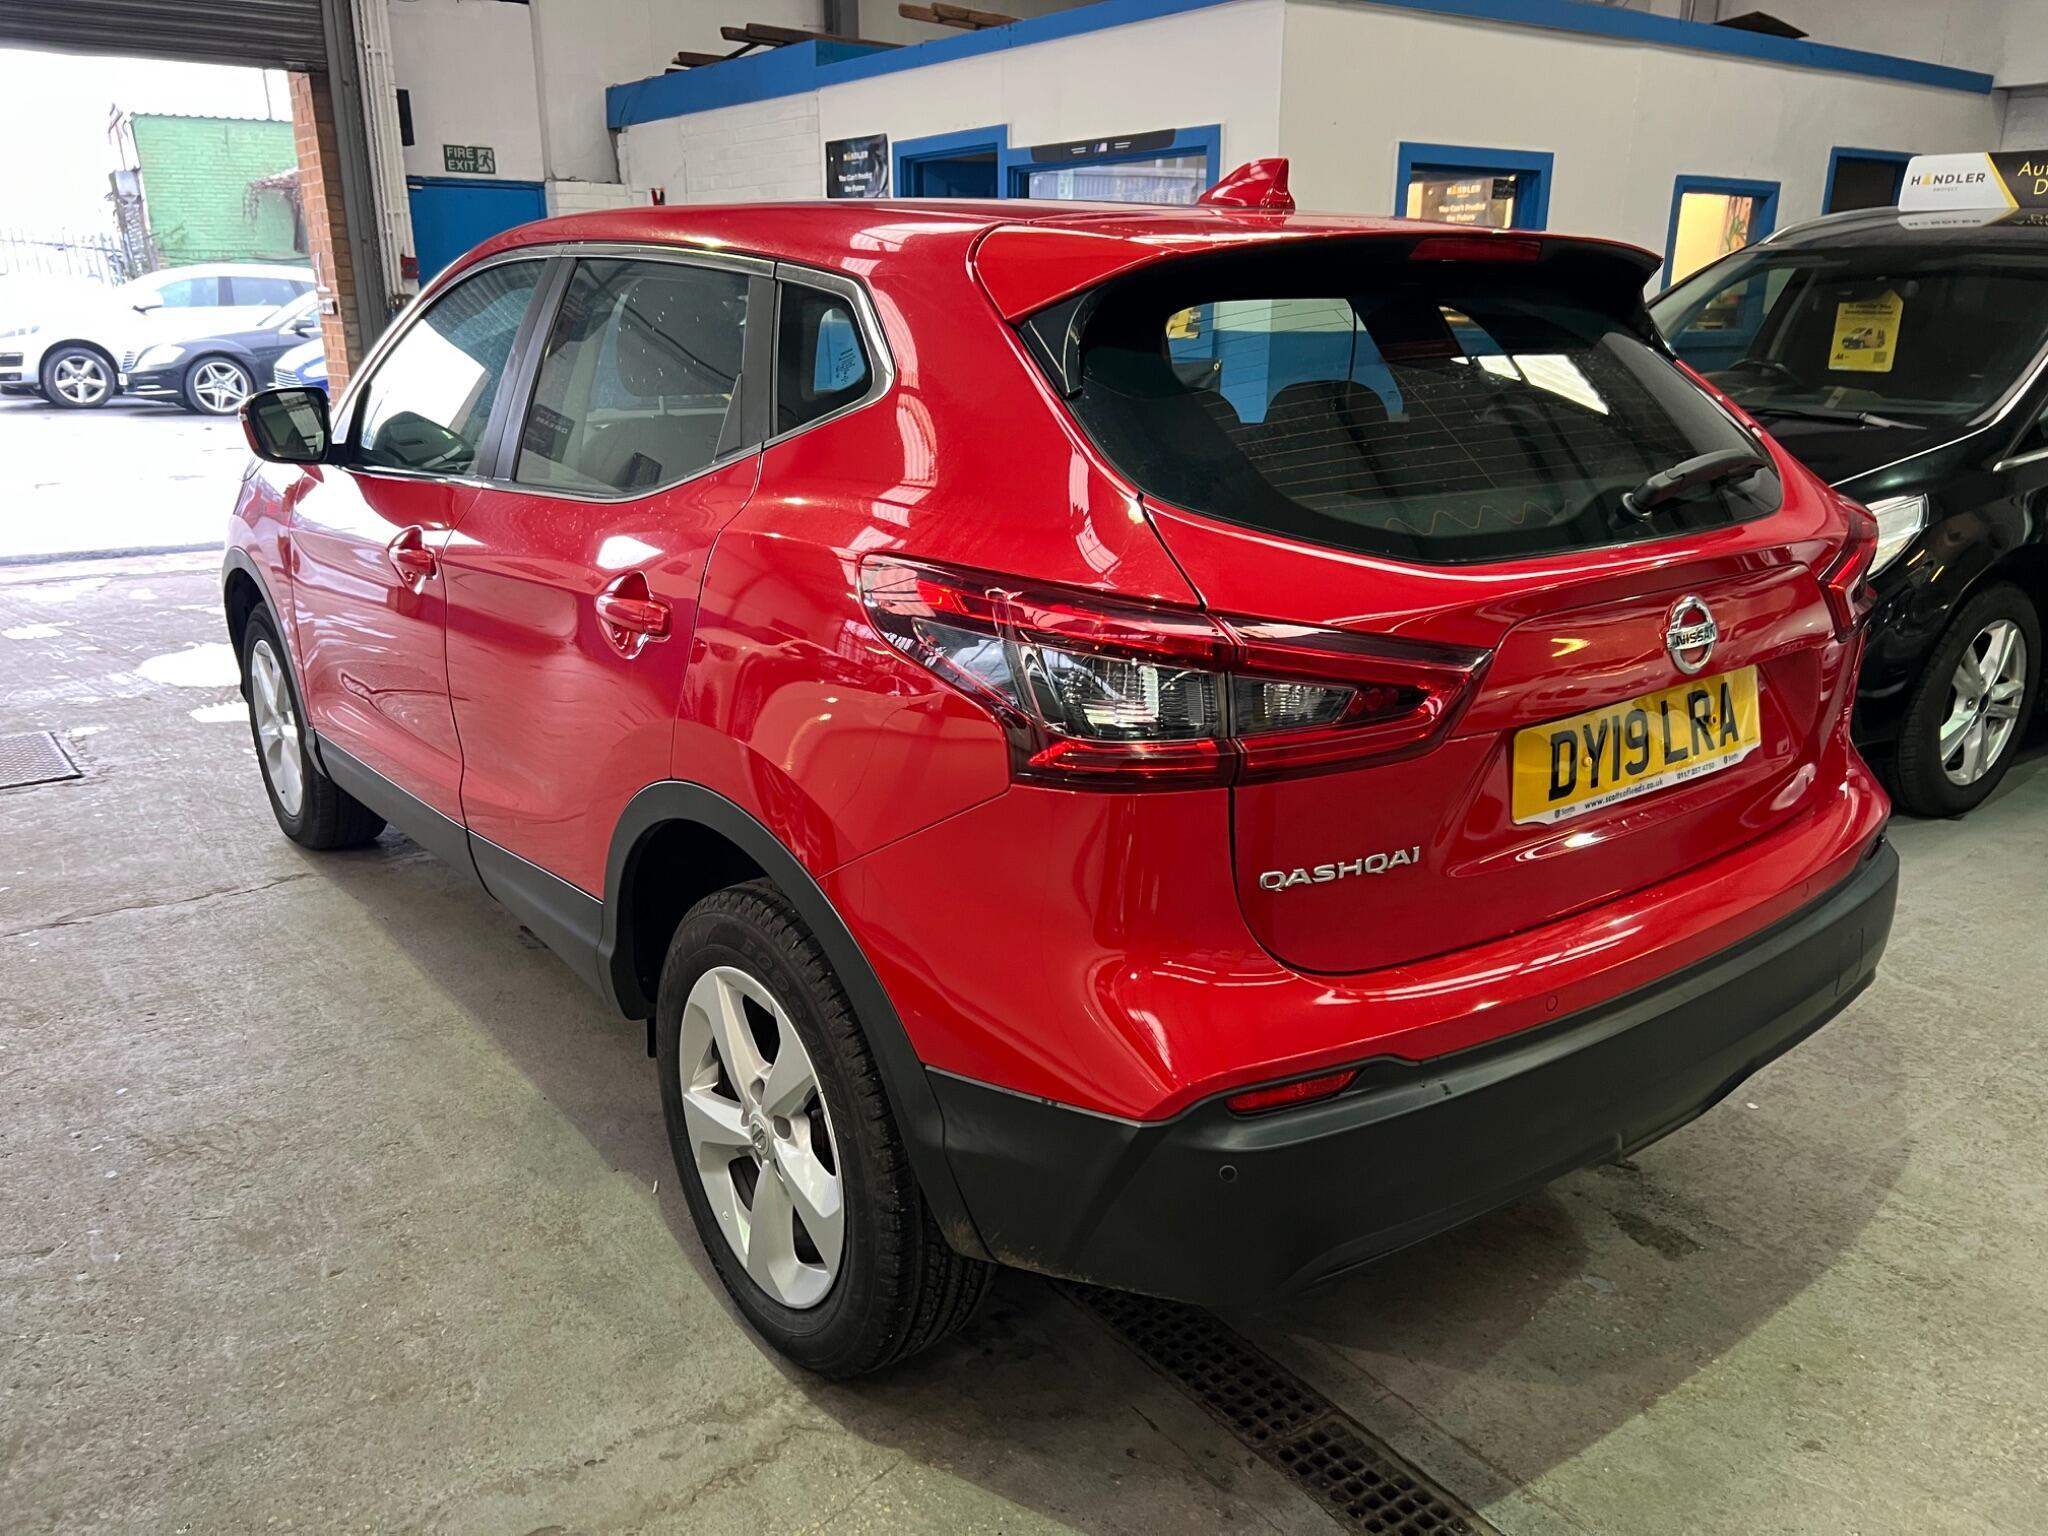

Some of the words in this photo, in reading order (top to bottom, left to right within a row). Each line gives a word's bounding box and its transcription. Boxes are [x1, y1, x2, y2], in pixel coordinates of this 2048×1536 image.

[446, 147, 474, 159] FIRE
[448, 160, 475, 171] EXIT
[1910, 171, 1986, 188] HANDLER
[1676, 627, 1716, 646] NISSAN
[1548, 708, 1649, 801] DY19
[1660, 682, 1739, 765] LRA
[1259, 846, 1420, 892] QASHQAI
